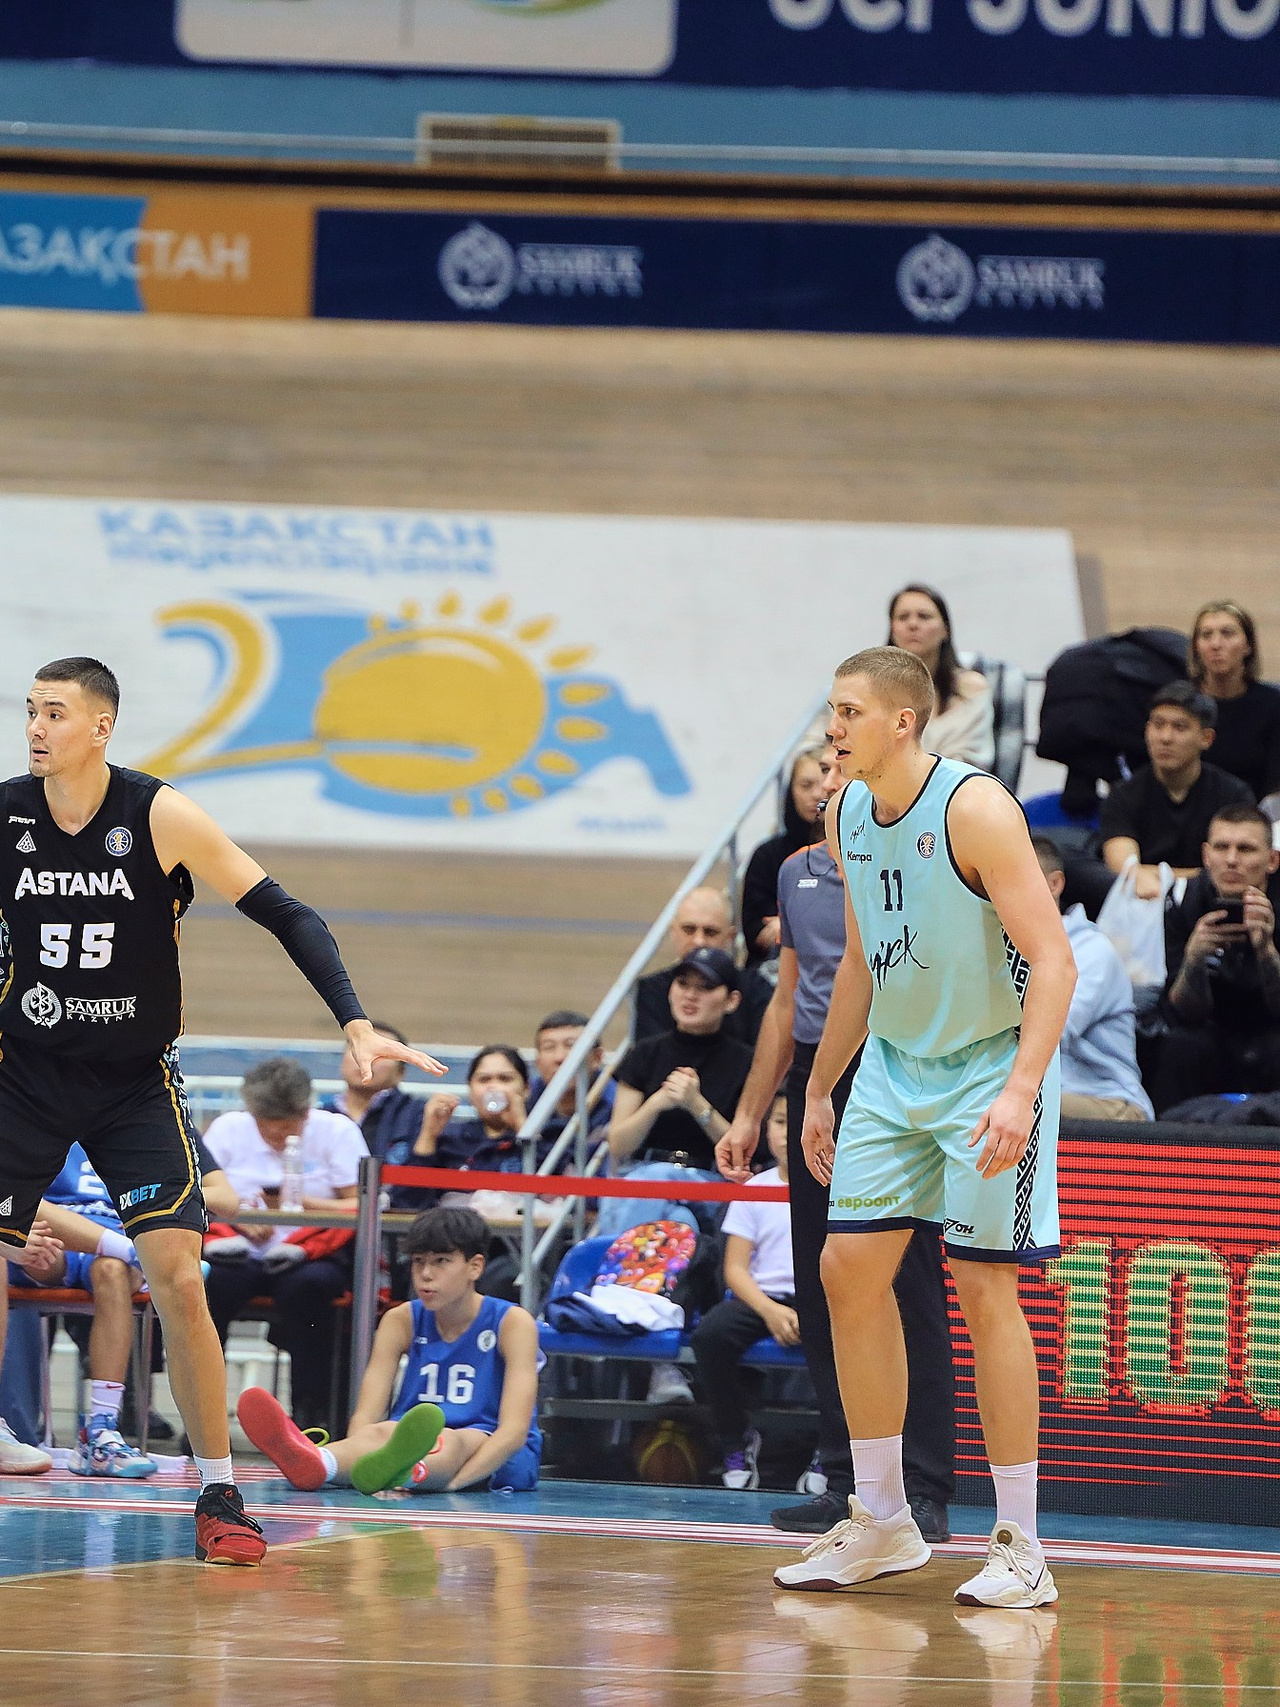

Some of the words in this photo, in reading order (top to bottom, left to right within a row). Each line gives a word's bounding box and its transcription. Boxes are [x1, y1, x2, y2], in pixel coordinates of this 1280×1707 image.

[847, 850, 873, 864] Kempa
[15, 867, 135, 901] ASTANA
[880, 868, 904, 912] 11
[39, 922, 115, 969] 55
[65, 998, 137, 1017] SAMRUK
[66, 1011, 136, 1025] KAZYNA
[838, 1195, 901, 1211] евроопт
[418, 1363, 476, 1404] 16
